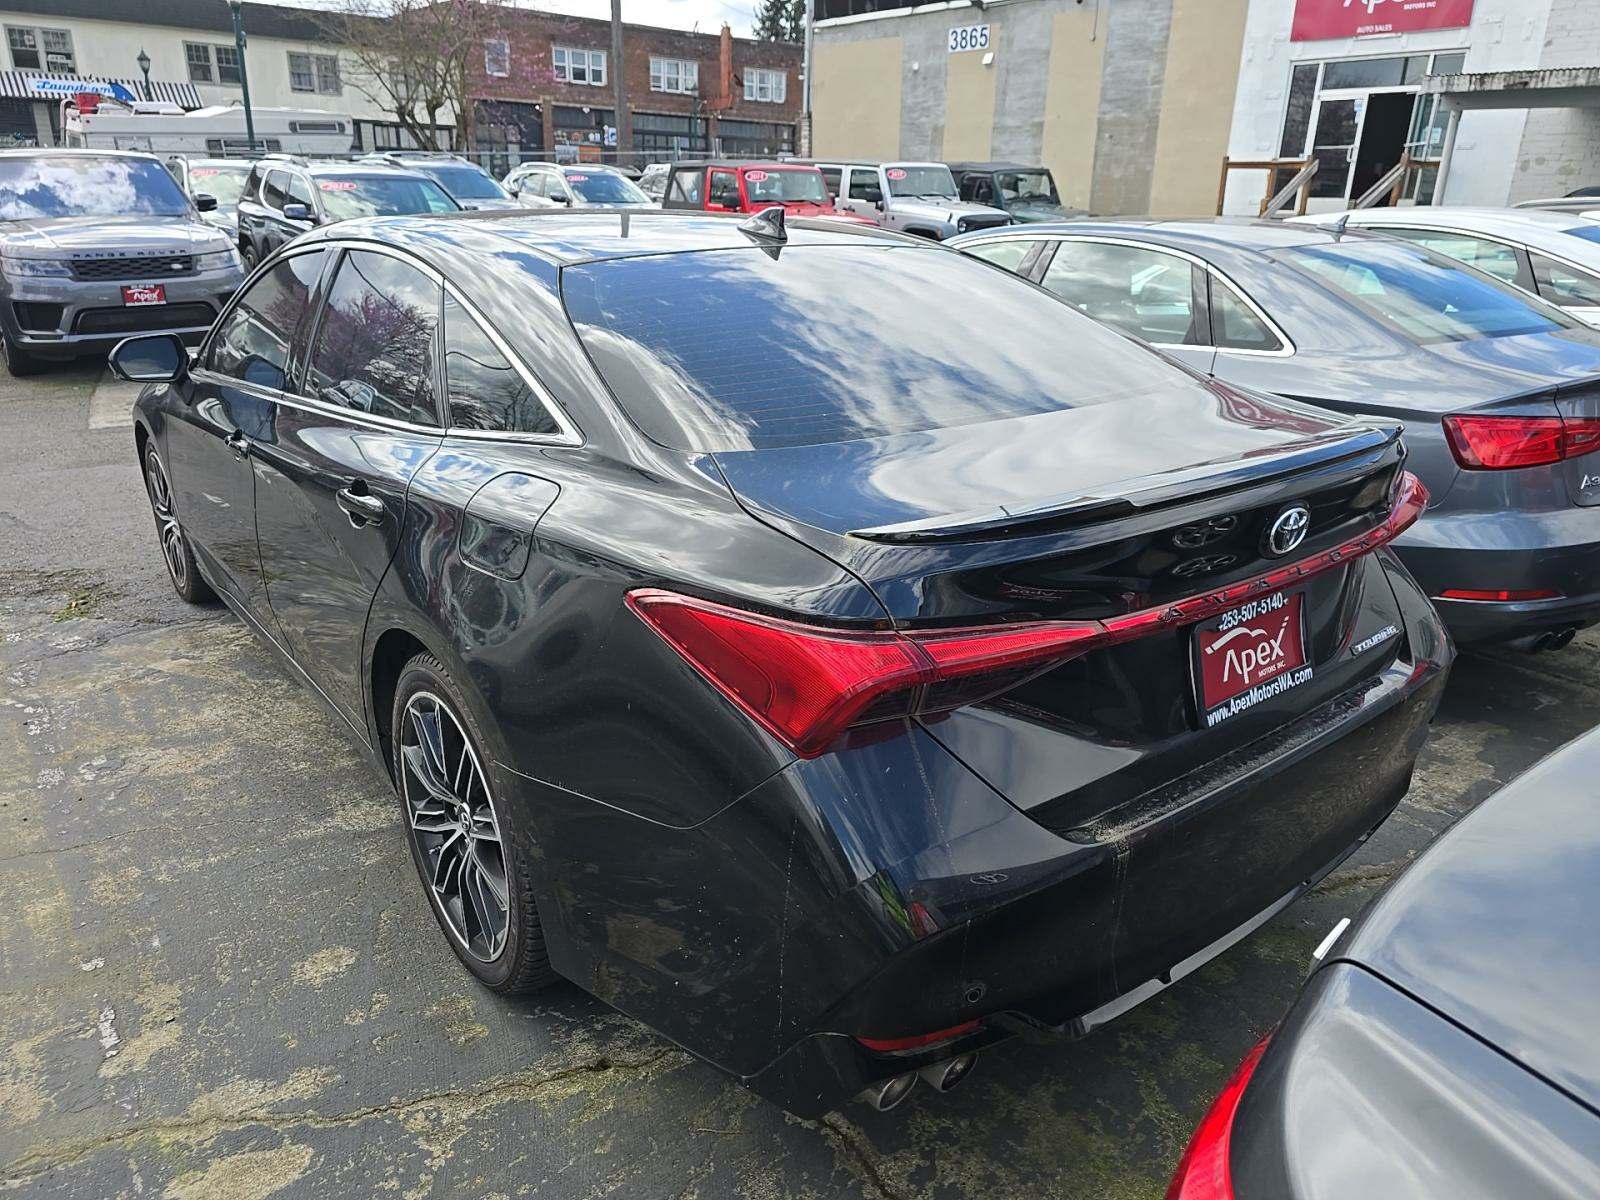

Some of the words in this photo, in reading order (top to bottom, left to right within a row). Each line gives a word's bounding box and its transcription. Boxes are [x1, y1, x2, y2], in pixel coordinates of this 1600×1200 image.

[950, 27, 988, 50] 3865
[1356, 25, 1373, 33] AUTO
[1374, 23, 1392, 32] SALES
[134, 289, 159, 301] Apex
[1355, 625, 1398, 652] TOURING
[1223, 627, 1285, 684] Apex
[1258, 664, 1277, 678] MOTORS
[1207, 667, 1313, 727] www.ApexMotorsWA.com
